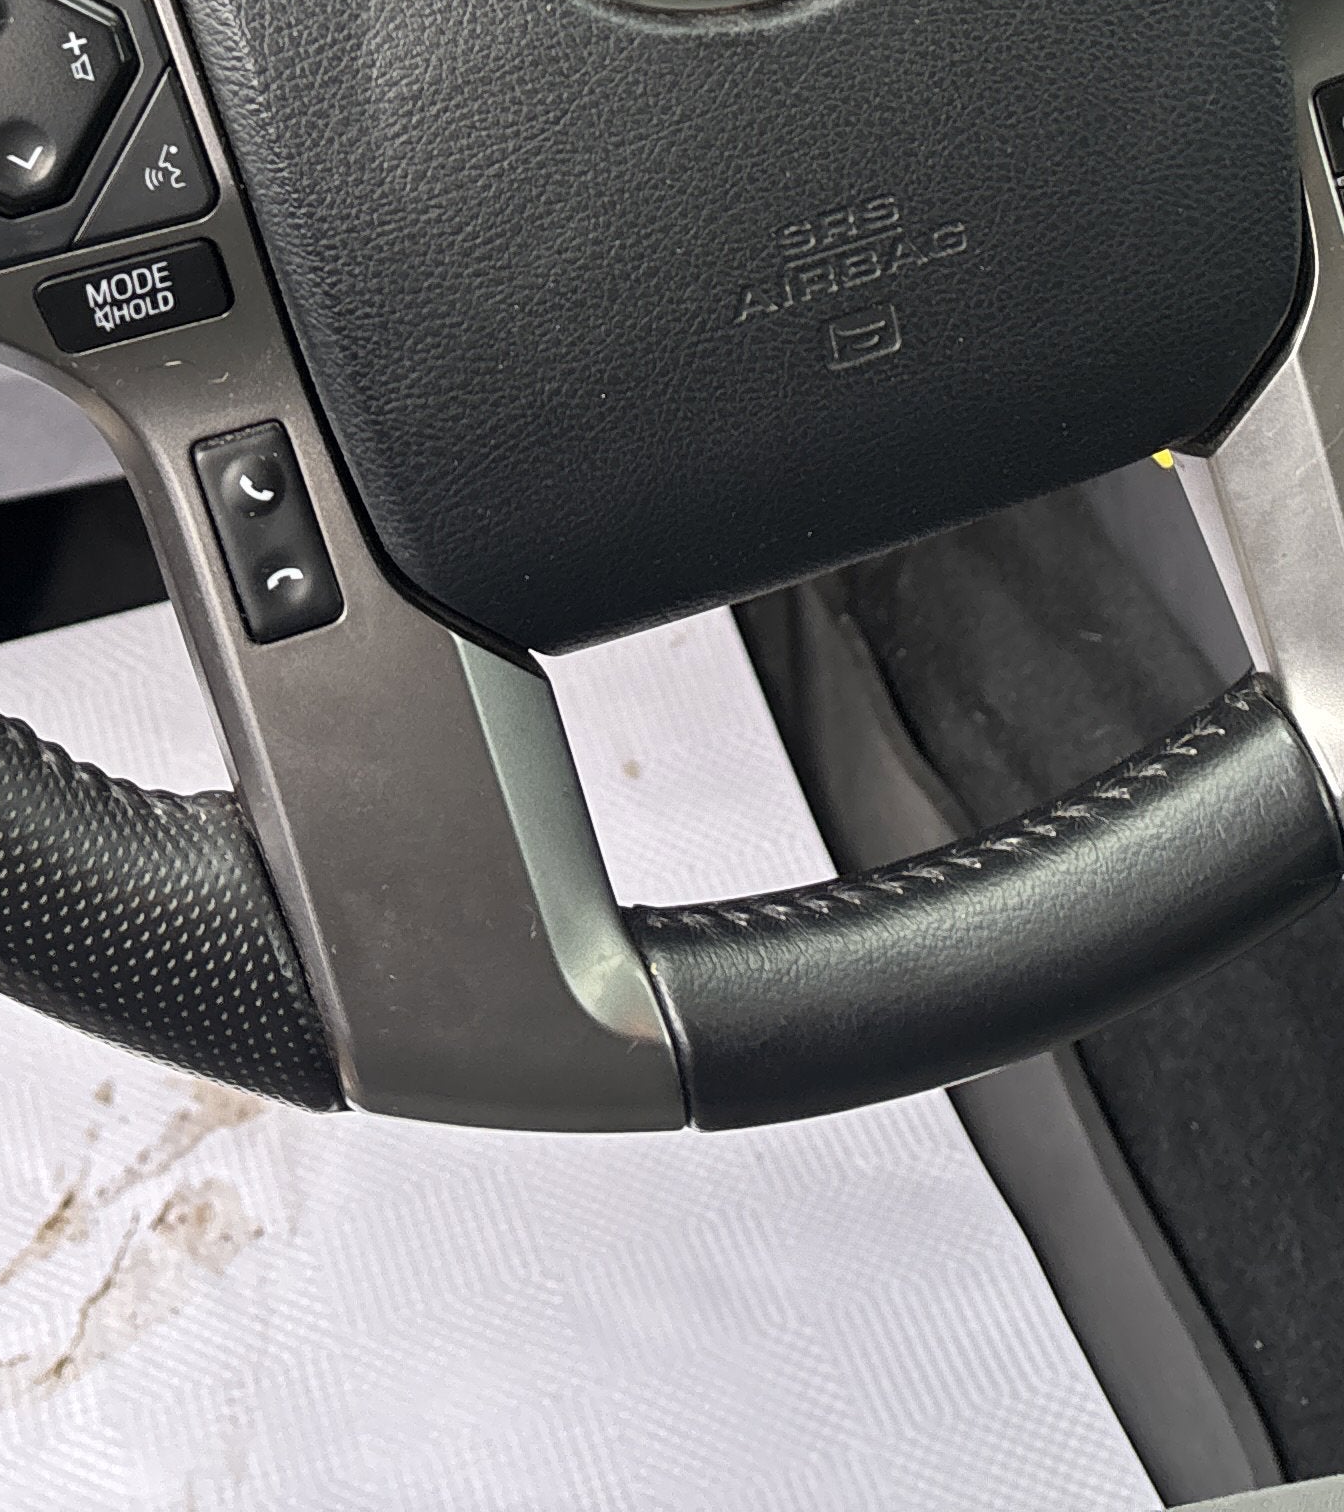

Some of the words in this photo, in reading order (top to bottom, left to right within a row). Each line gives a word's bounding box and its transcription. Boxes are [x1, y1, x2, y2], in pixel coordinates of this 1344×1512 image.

[780, 196, 900, 256] SRS
[85, 261, 172, 309] MODE
[111, 288, 175, 329] HOLD
